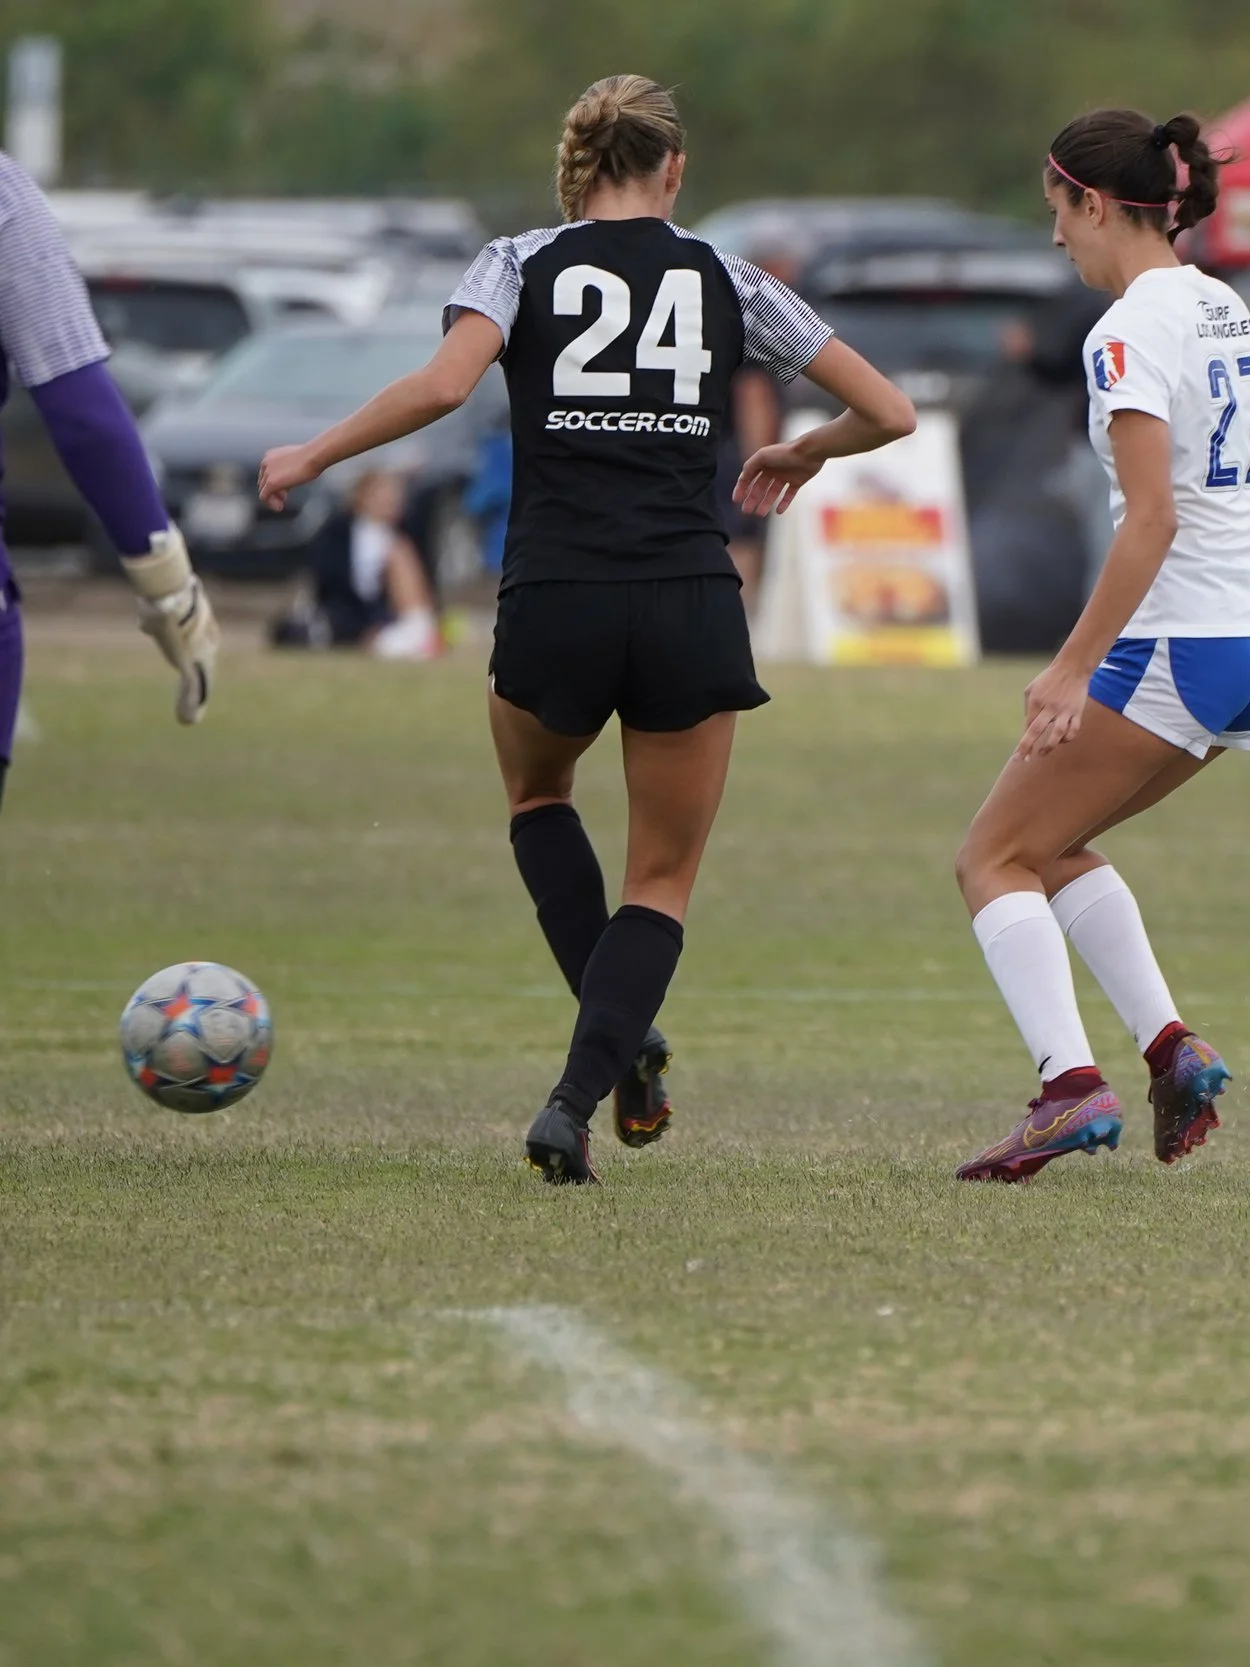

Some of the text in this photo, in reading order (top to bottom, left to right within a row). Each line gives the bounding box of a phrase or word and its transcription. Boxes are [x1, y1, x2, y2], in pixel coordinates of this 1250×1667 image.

[1205, 306, 1230, 321] SURF
[552, 264, 712, 405] 24
[545, 410, 711, 437] SOCCER.COM
